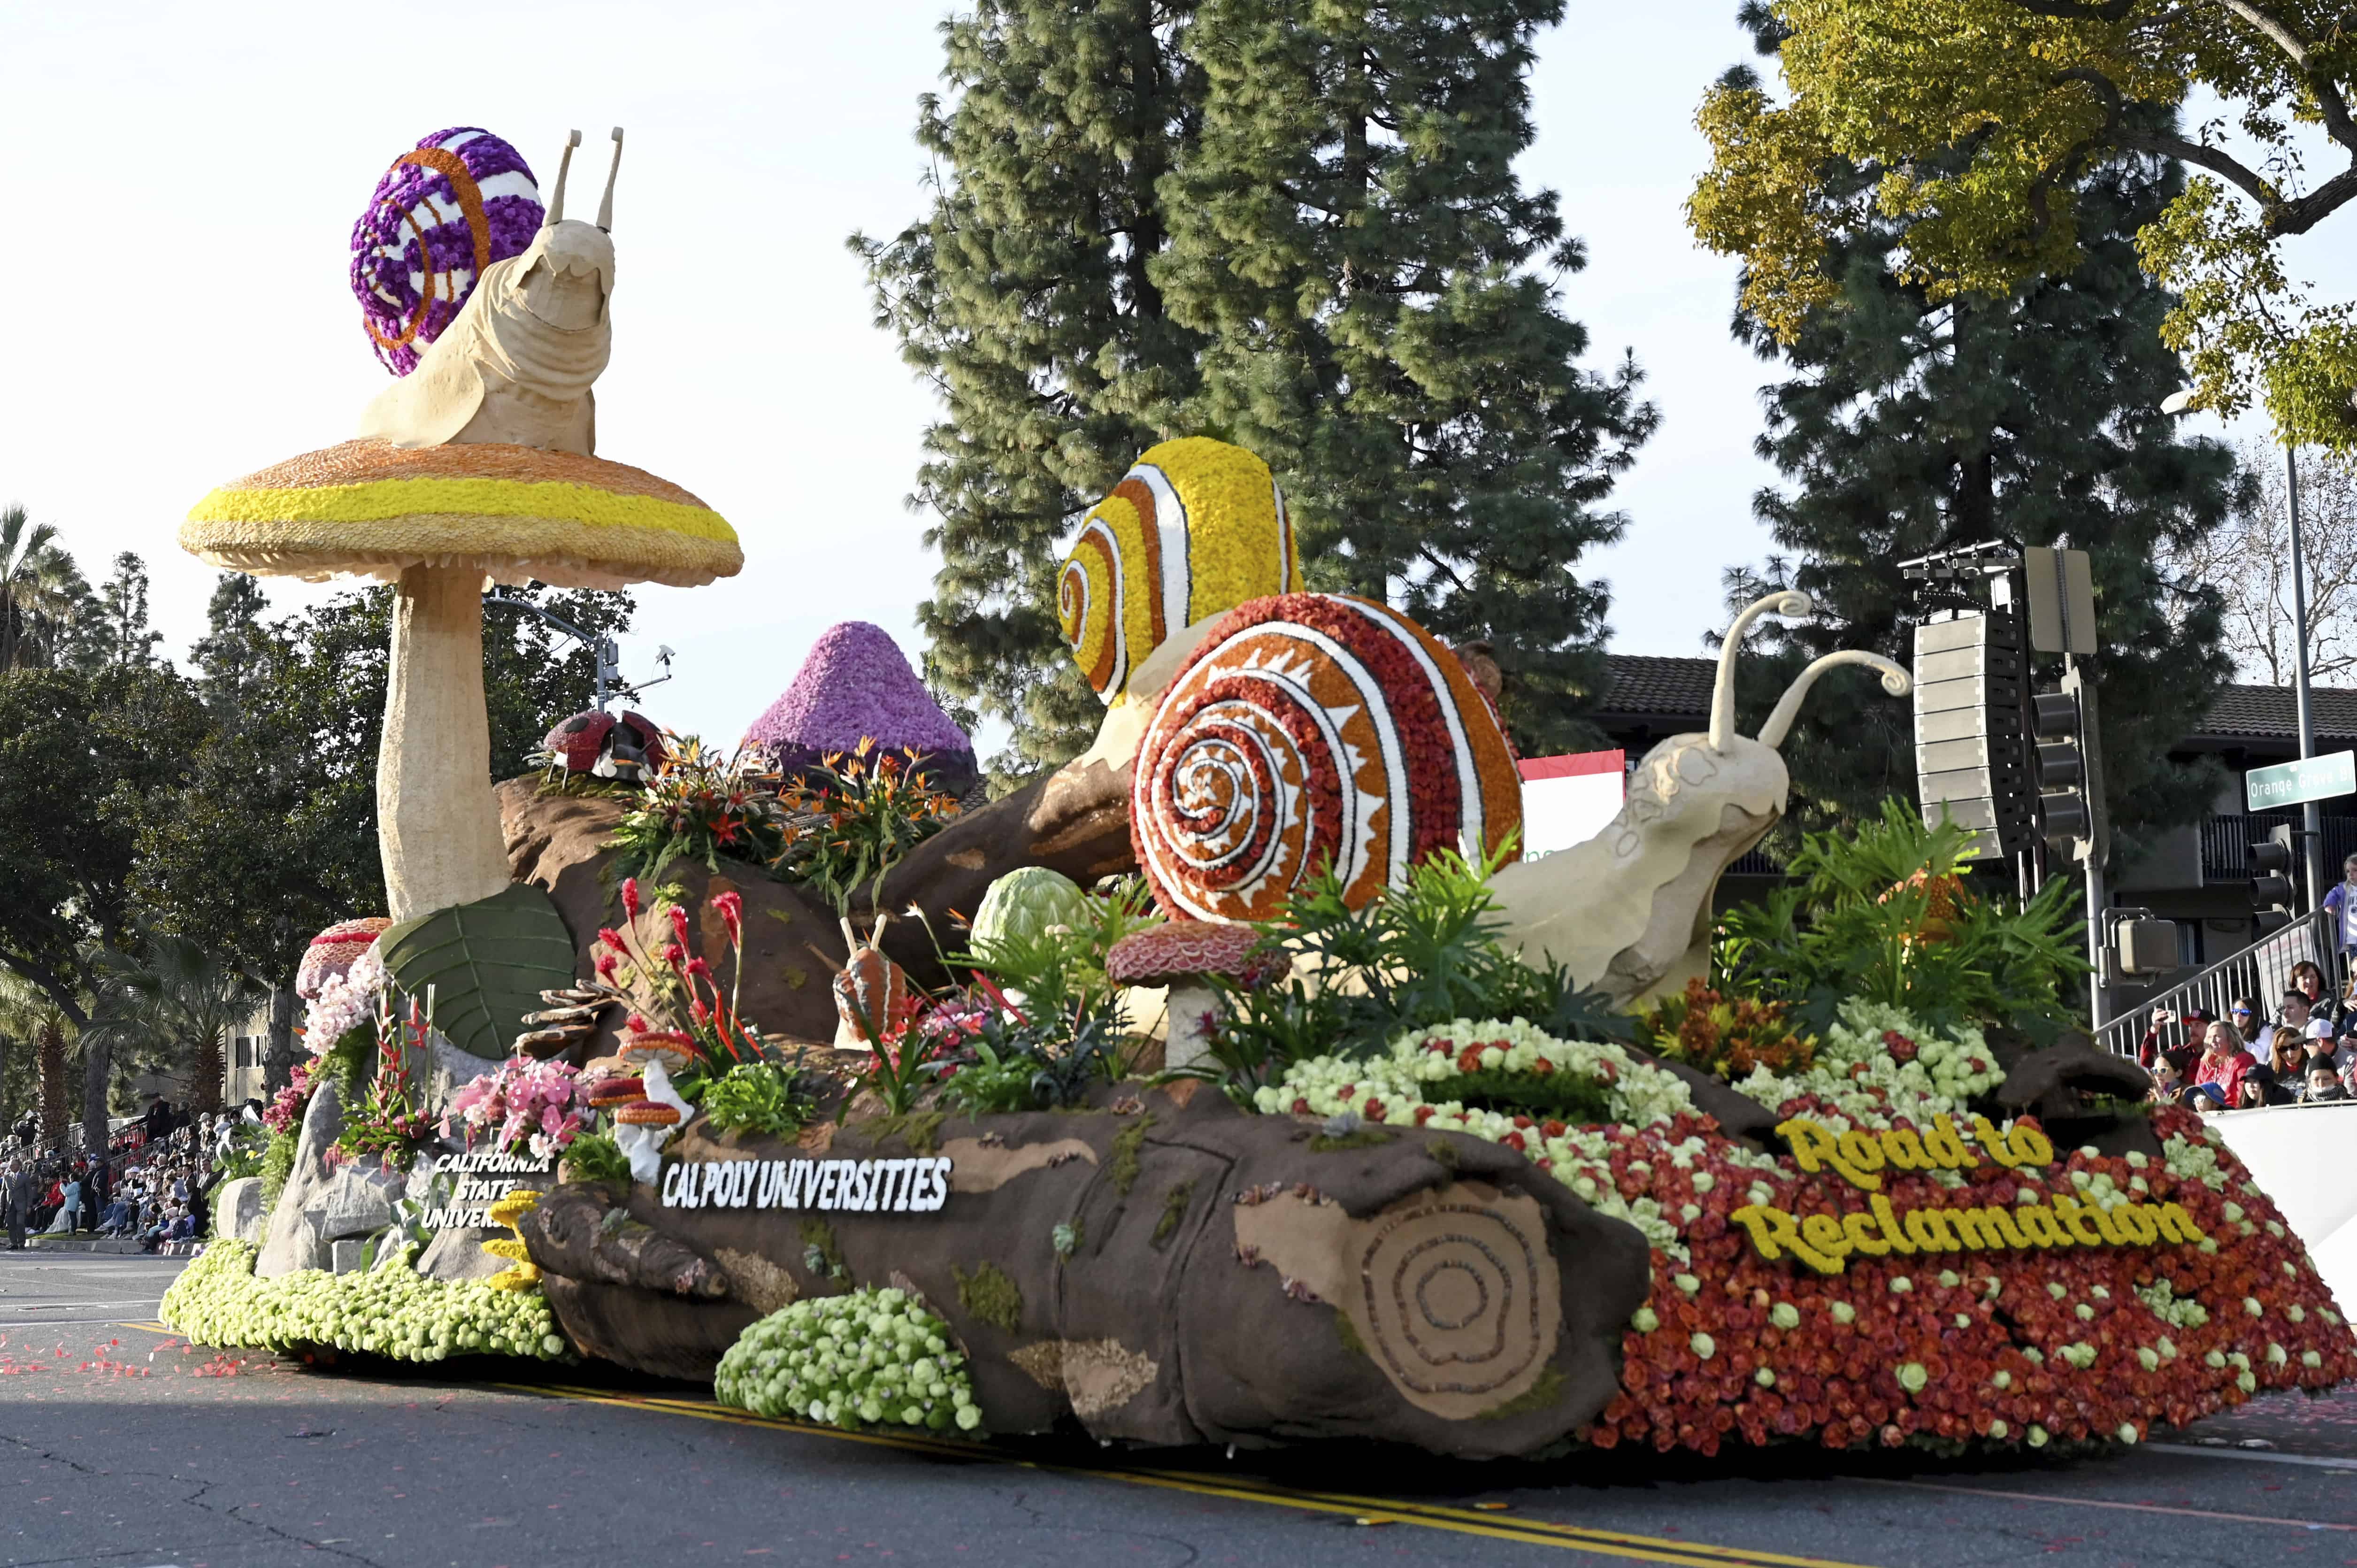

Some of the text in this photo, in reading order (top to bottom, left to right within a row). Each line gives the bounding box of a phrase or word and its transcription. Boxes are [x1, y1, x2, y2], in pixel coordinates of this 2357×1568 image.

[2251, 779, 2293, 797] Orange
[434, 1152, 549, 1173] CALIFORNIA
[1775, 1113, 2053, 1191] Road to
[459, 1179, 515, 1200] STATE
[662, 1157, 952, 1211] CAL POLY UNIVERSITIES
[421, 1207, 510, 1228] UNIVER
[1731, 1191, 2204, 1274] Reclamation
